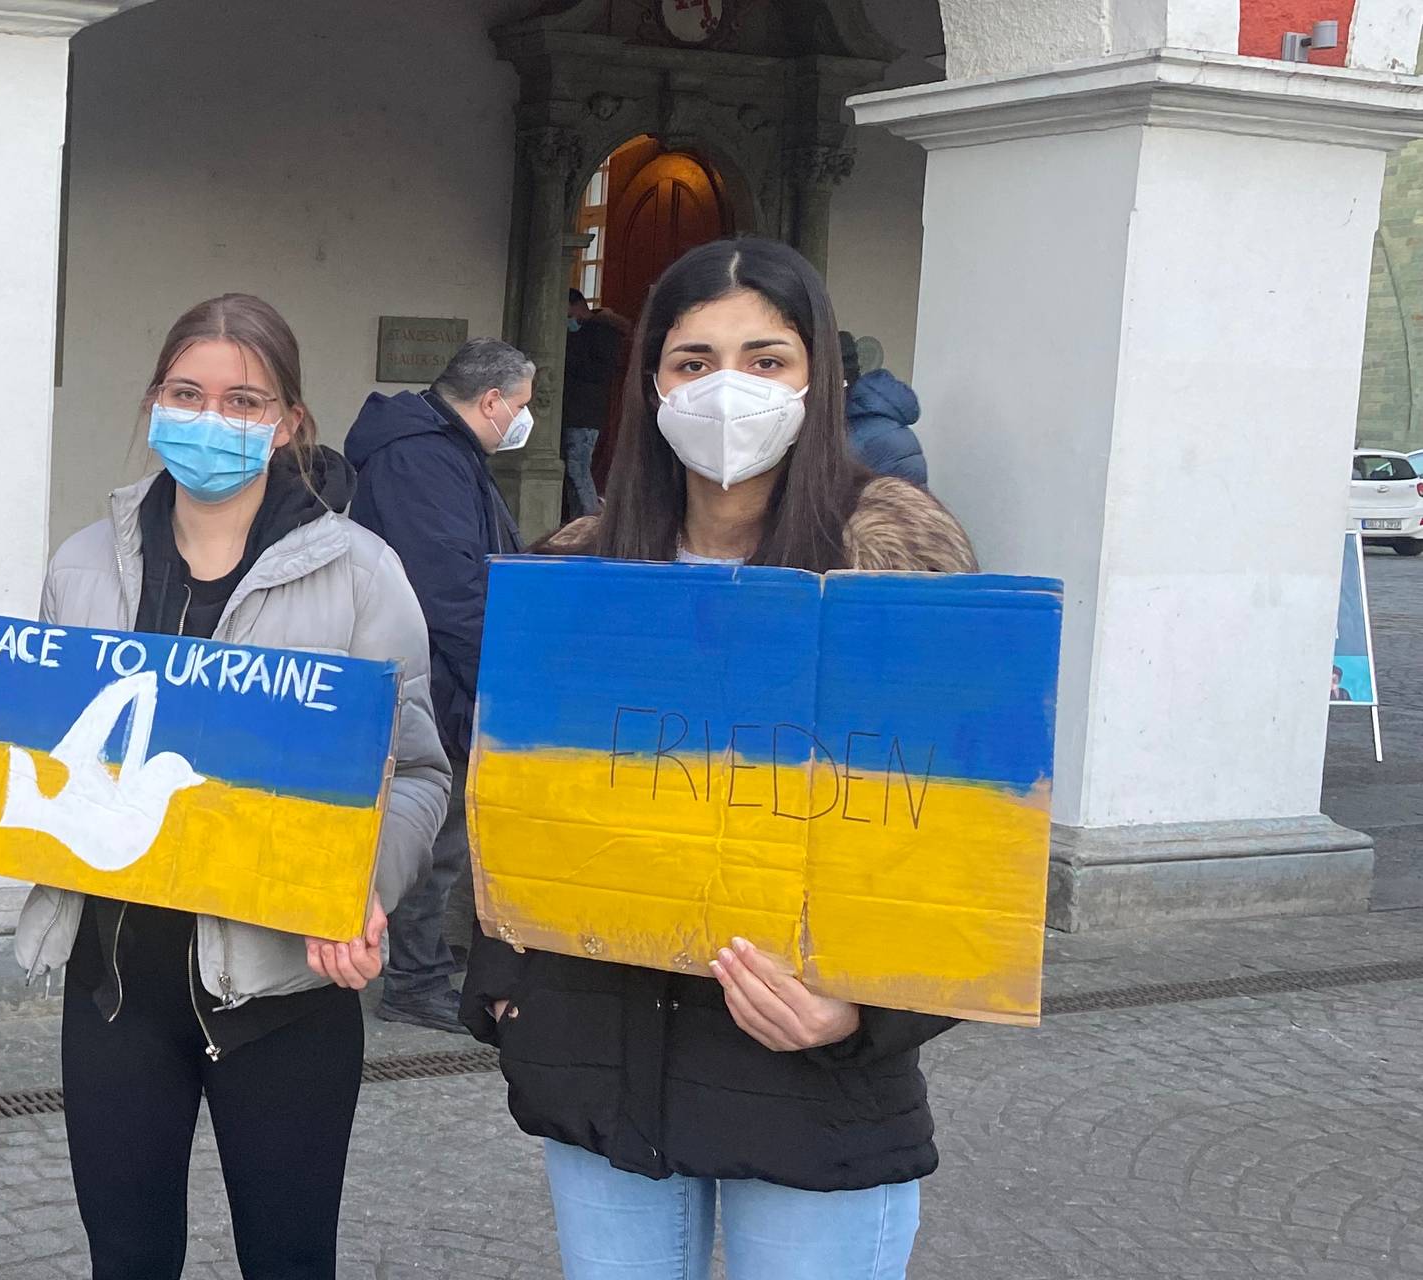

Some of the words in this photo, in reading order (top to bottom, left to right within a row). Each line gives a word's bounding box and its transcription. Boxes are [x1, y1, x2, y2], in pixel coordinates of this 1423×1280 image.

[91, 633, 148, 677] TO
[163, 642, 345, 712] UKRAINE
[608, 706, 937, 831] FRIEDEN
